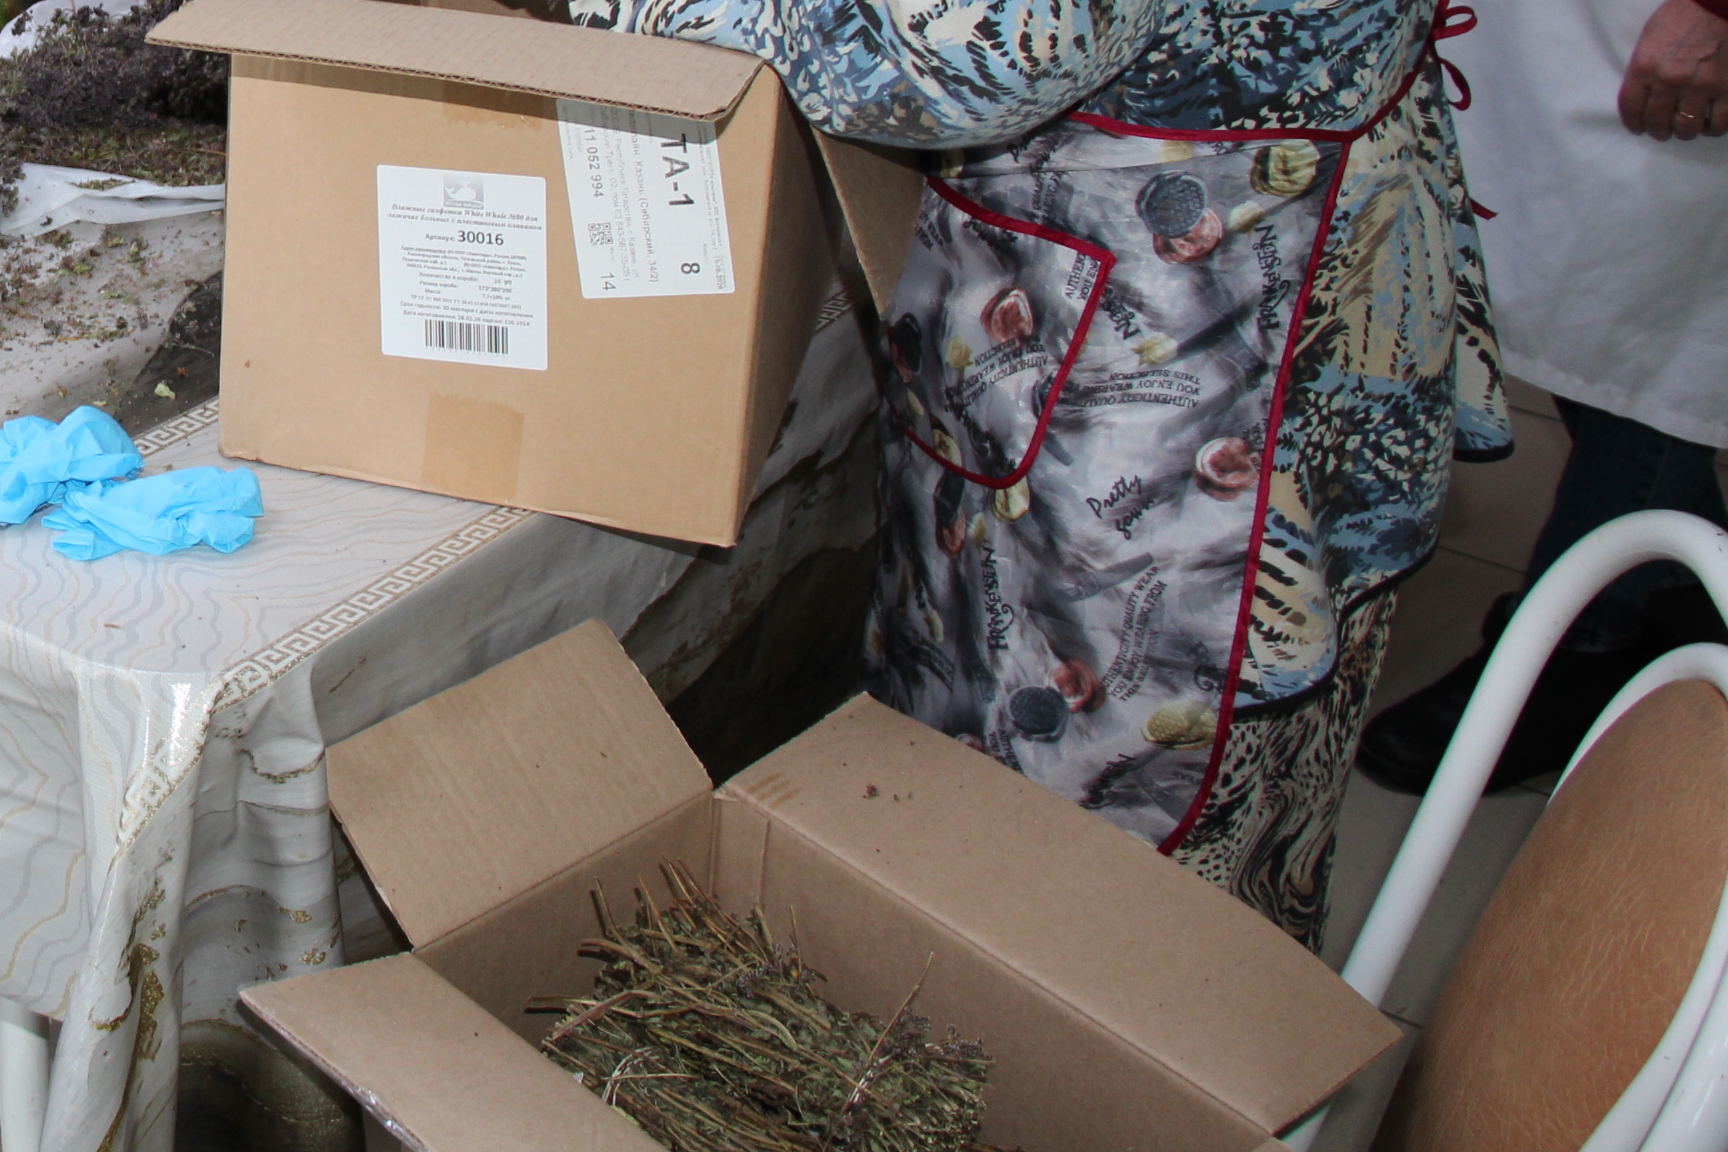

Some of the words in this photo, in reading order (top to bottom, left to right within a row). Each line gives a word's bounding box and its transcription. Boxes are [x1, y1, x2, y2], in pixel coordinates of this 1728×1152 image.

[586, 147, 601, 170] 052
[590, 174, 605, 198] 994
[425, 233, 455, 243] Артикул:
[457, 229, 504, 246] 30016
[679, 262, 702, 275] 8
[600, 272, 617, 291] 14
[1136, 378, 1173, 390] ENJOY
[1176, 383, 1201, 396] YOU
[1086, 474, 1143, 519] Pretty
[1124, 591, 1140, 630] QUALITY
[1134, 566, 1161, 592] WEAR
[1108, 681, 1127, 697] YOU
[1146, 580, 1168, 607] FROM
